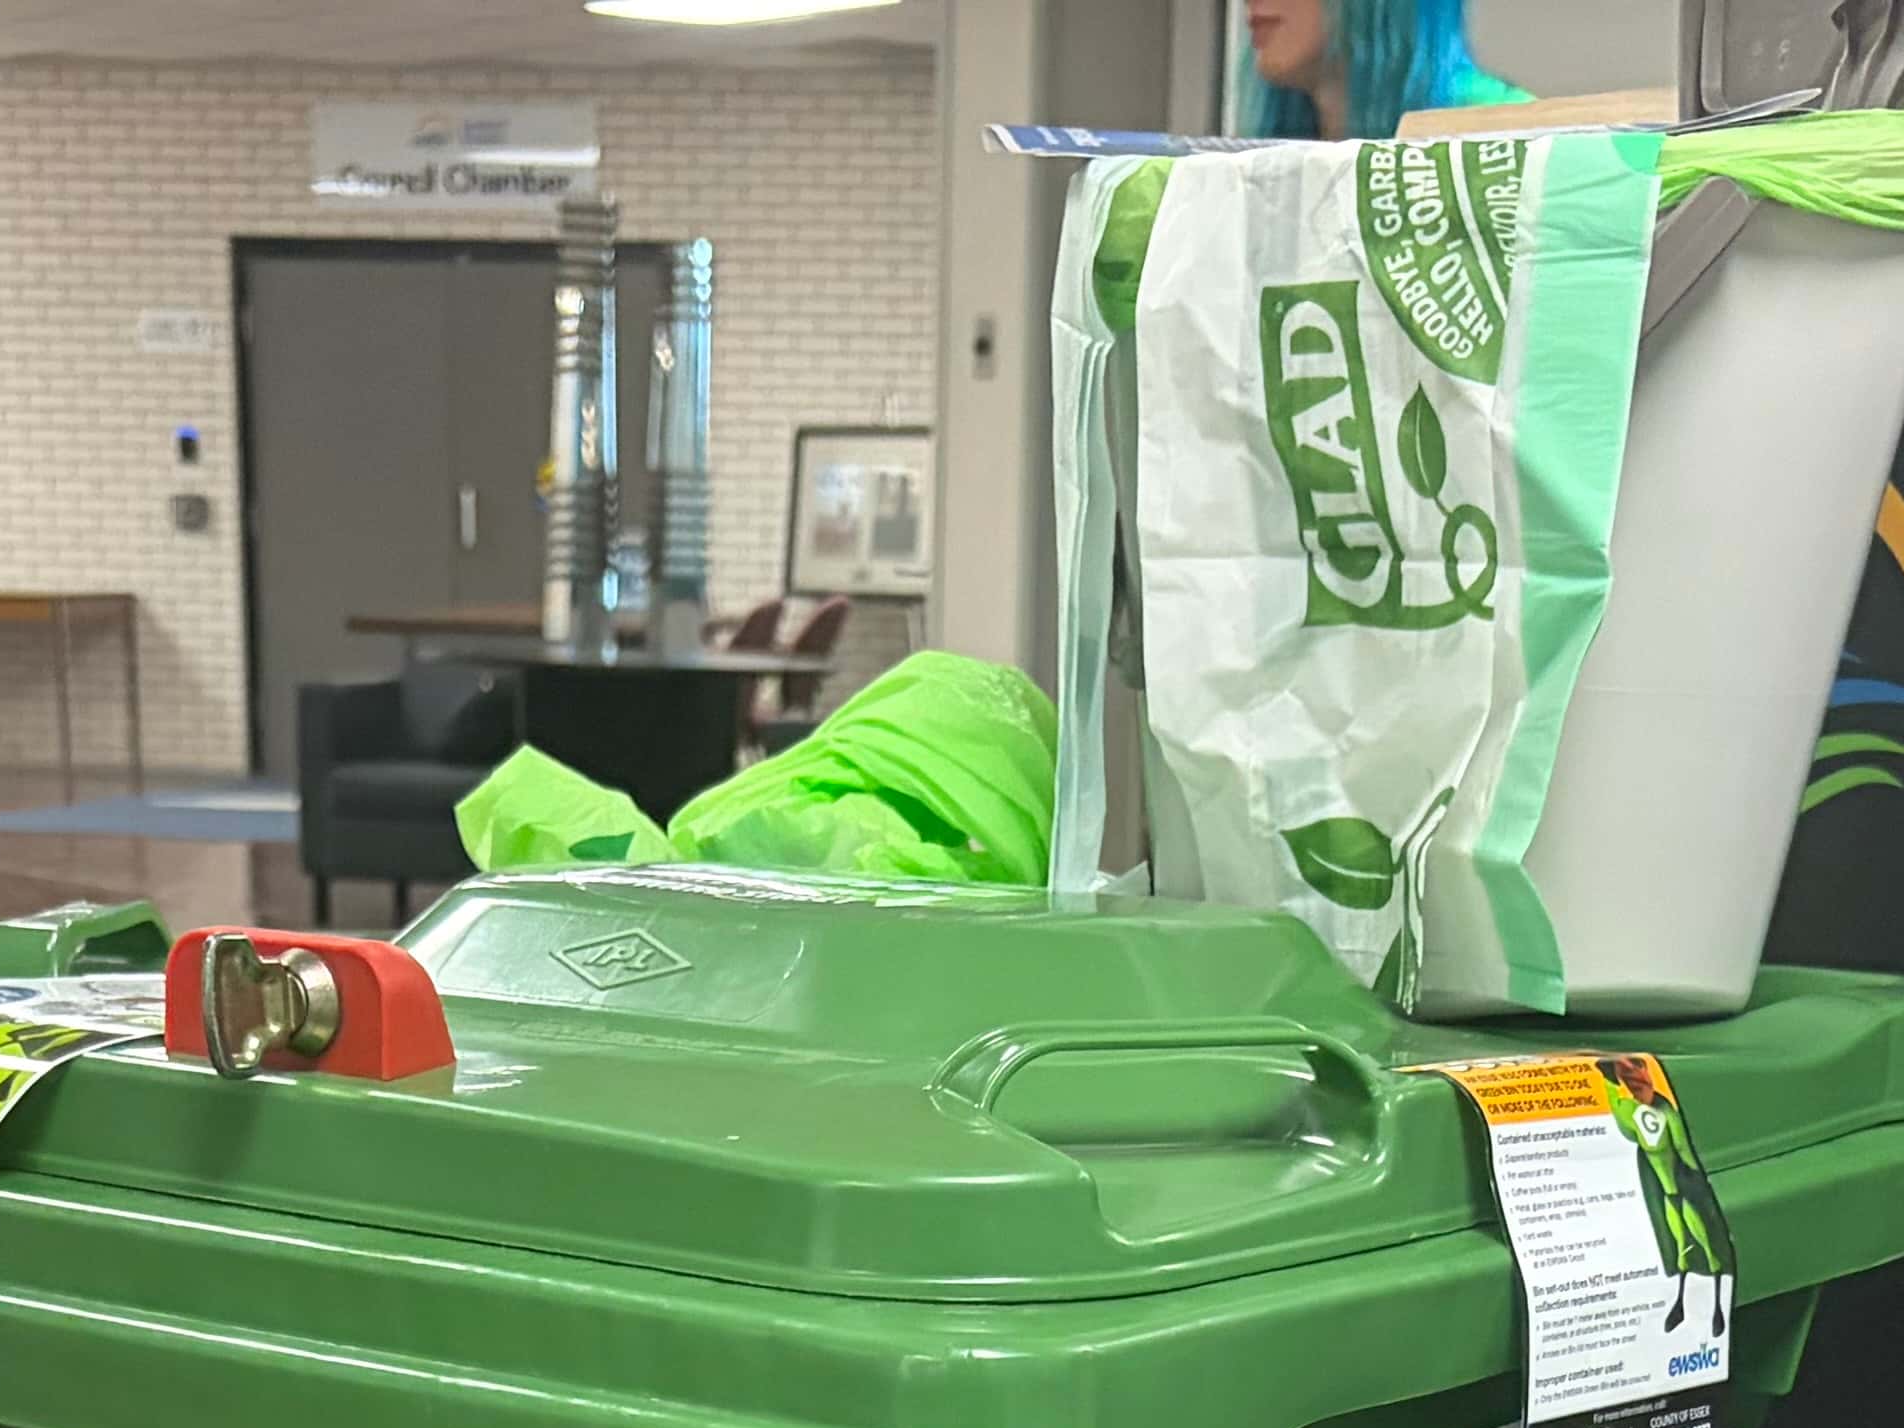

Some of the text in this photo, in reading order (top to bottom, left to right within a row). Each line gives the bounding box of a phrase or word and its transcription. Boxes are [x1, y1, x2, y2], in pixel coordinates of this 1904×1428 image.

[1383, 239, 1474, 359] GOODBYE,
[1430, 238, 1494, 346] HELLO,
[1278, 297, 1395, 608] GLAD
[1668, 1345, 1720, 1377] ewswa
